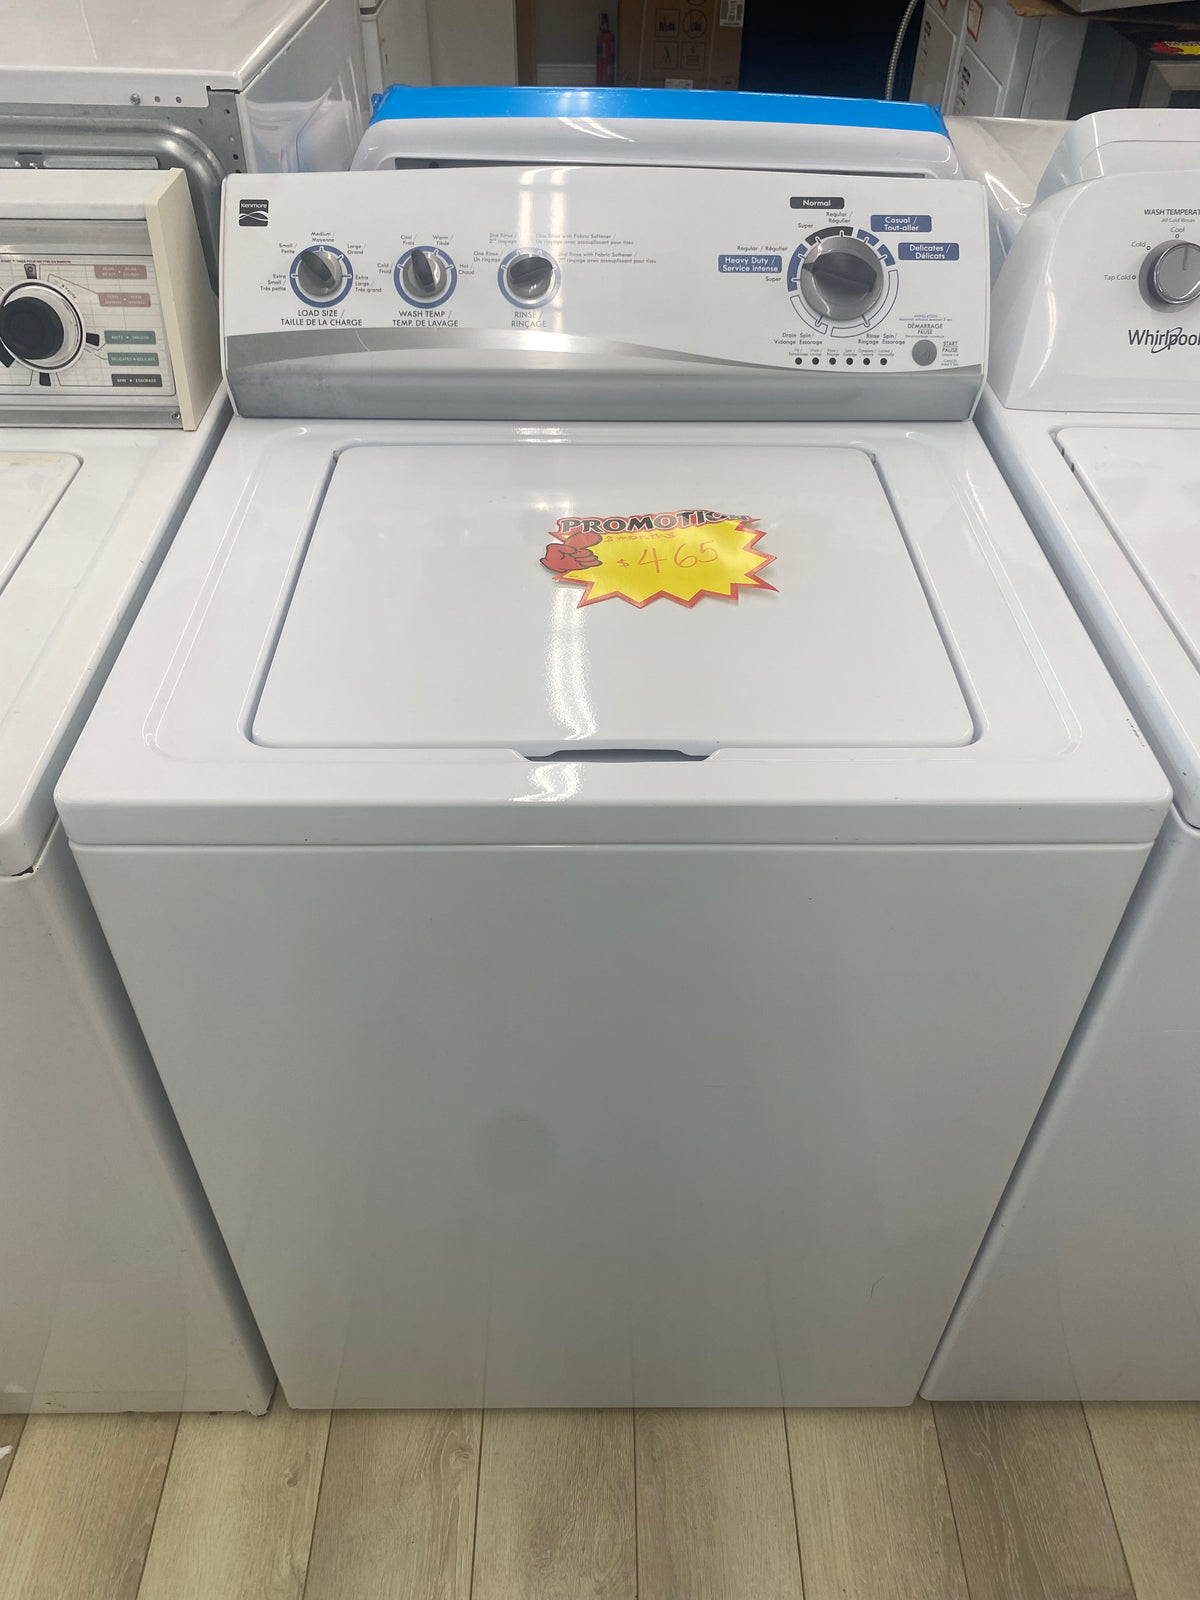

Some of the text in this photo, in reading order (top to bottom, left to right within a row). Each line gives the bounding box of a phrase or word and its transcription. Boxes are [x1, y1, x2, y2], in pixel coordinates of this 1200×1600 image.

[802, 199, 831, 207] Normal
[884, 216, 910, 224] Casual
[909, 244, 944, 252] Delicates
[915, 252, 945, 260] Délicats
[725, 256, 749, 265] Heavy
[751, 256, 769, 265] Duty
[1104, 274, 1116, 282] Tap
[298, 309, 320, 317] LOAD
[321, 309, 338, 317] SIZE
[281, 318, 304, 326] TAILLE
[392, 319, 458, 327] TEMP. DE LAVAGE
[511, 320, 547, 329] RINÇAGE
[1128, 328, 1200, 352] Whirlpool
[617, 540, 718, 574] $ 465
